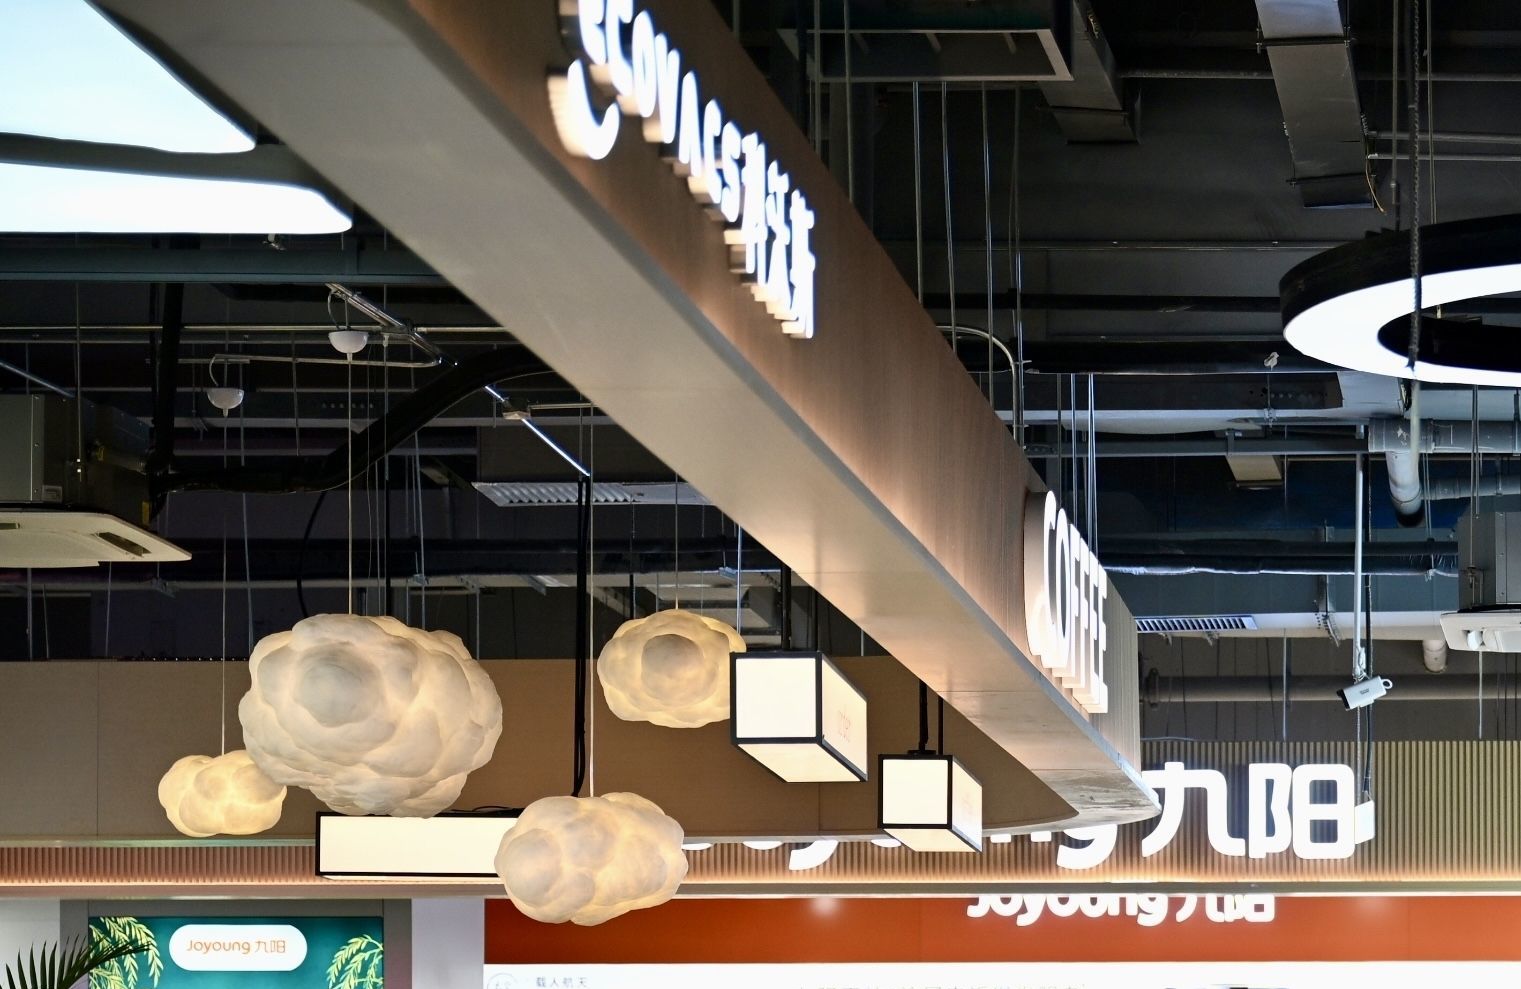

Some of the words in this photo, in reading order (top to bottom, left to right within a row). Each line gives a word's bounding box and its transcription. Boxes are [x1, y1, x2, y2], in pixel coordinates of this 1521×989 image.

[1041, 490, 1108, 714] COFFEE
[1141, 761, 1356, 860] 九阳
[187, 940, 251, 955] Joyoung
[254, 940, 286, 953] 九阳
